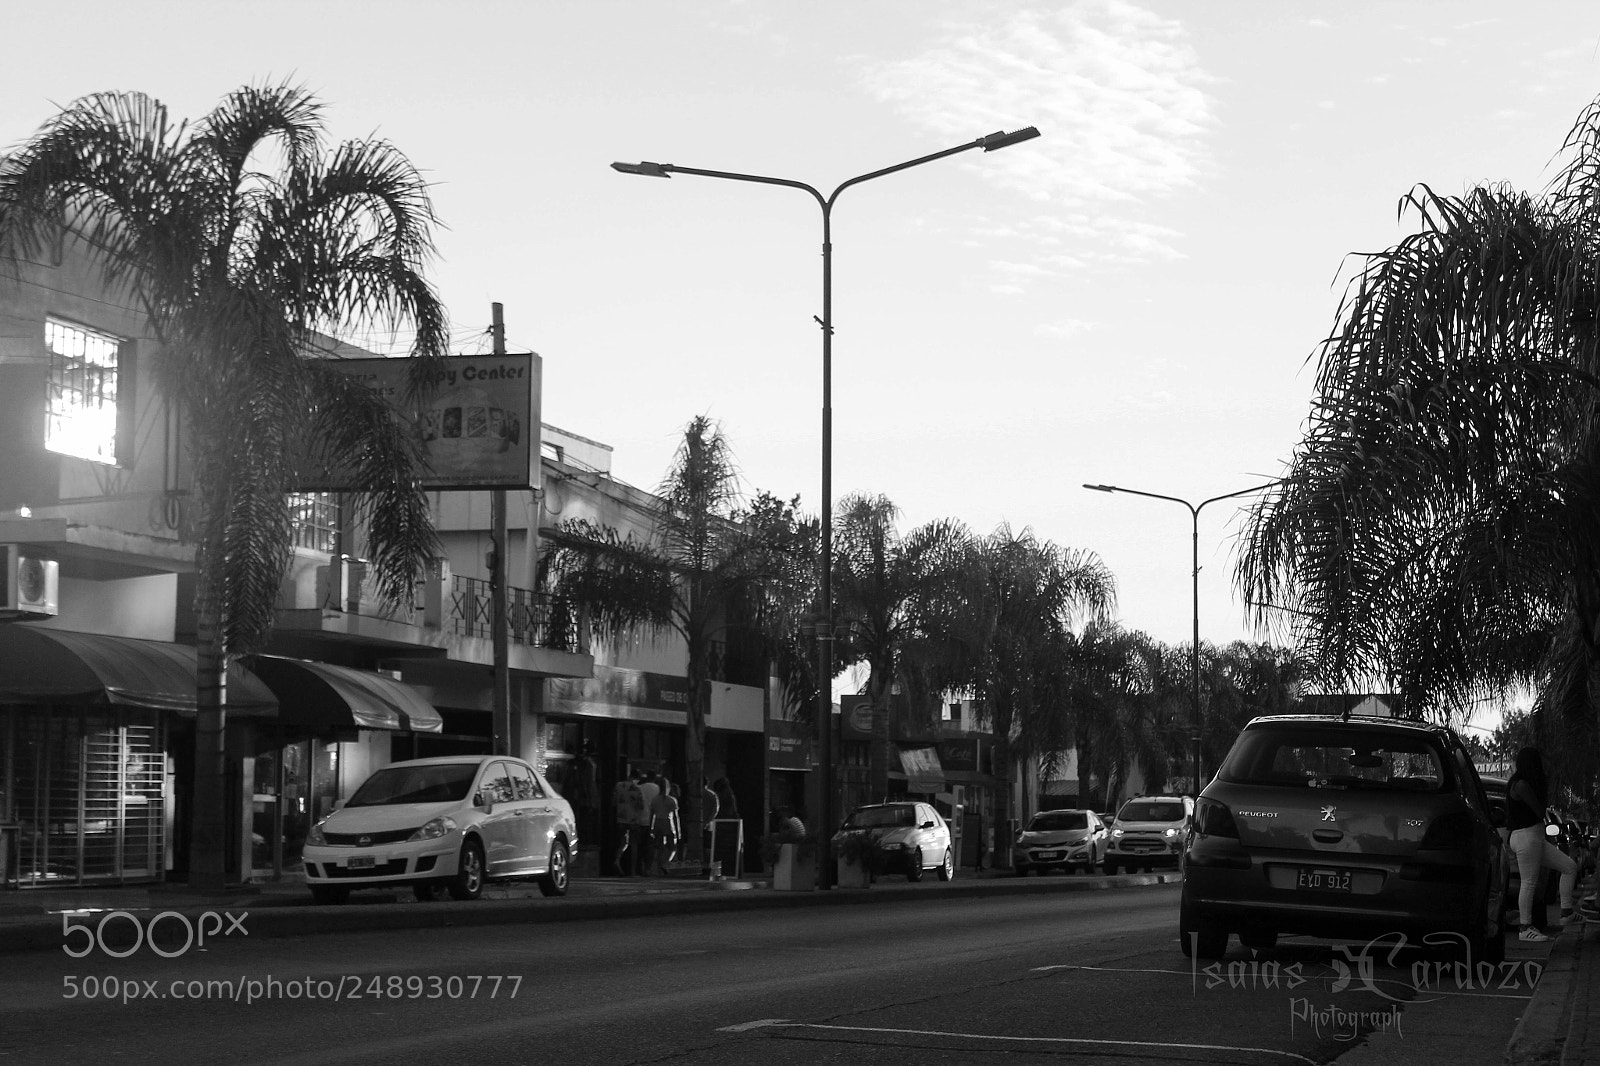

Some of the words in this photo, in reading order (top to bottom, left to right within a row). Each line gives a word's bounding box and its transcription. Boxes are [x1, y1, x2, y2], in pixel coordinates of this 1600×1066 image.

[462, 364, 524, 381] Center
[1238, 810, 1279, 819] PEUGEOT
[1299, 873, 1321, 888] EYD
[1327, 875, 1350, 890] 912
